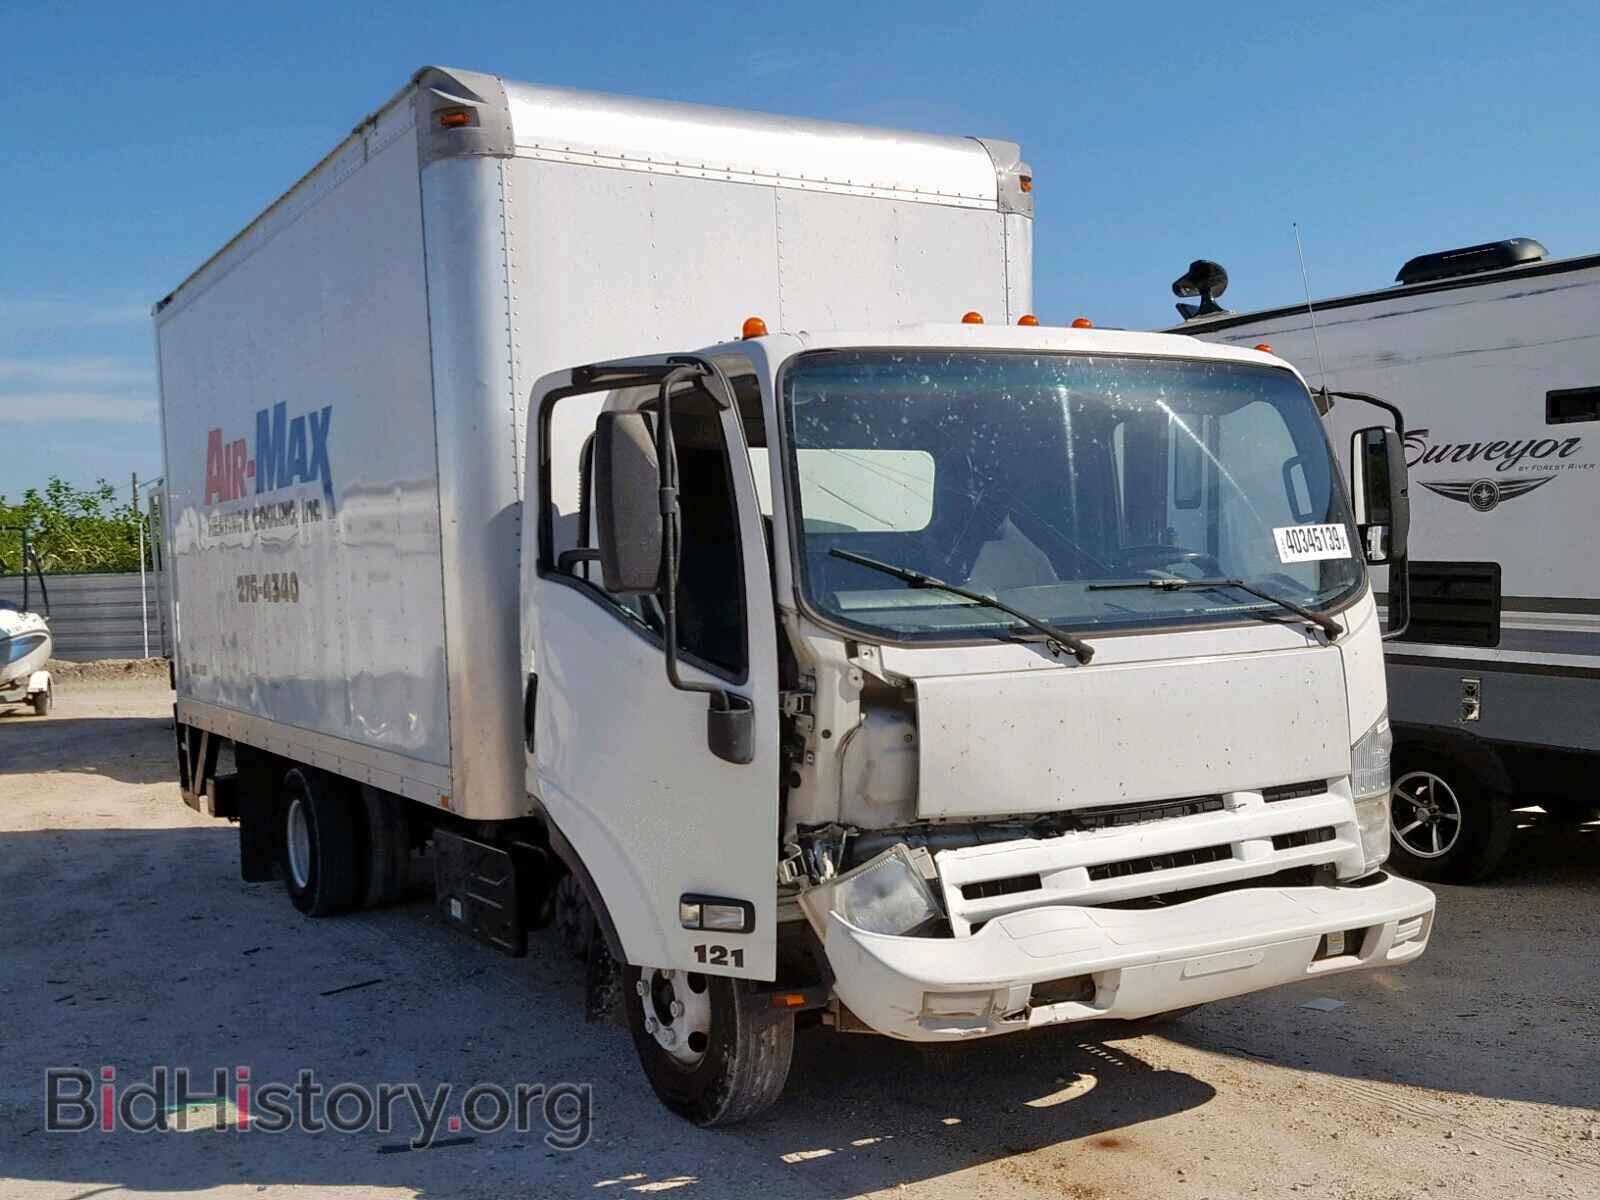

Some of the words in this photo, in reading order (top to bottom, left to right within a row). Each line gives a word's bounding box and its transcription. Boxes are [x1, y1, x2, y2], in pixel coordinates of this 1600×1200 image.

[1404, 428, 1582, 472] Surveyor
[1532, 463, 1565, 472] FOREST
[1567, 462, 1597, 472] RIVER
[1285, 525, 1342, 555] 40345139
[694, 944, 744, 968] 121
